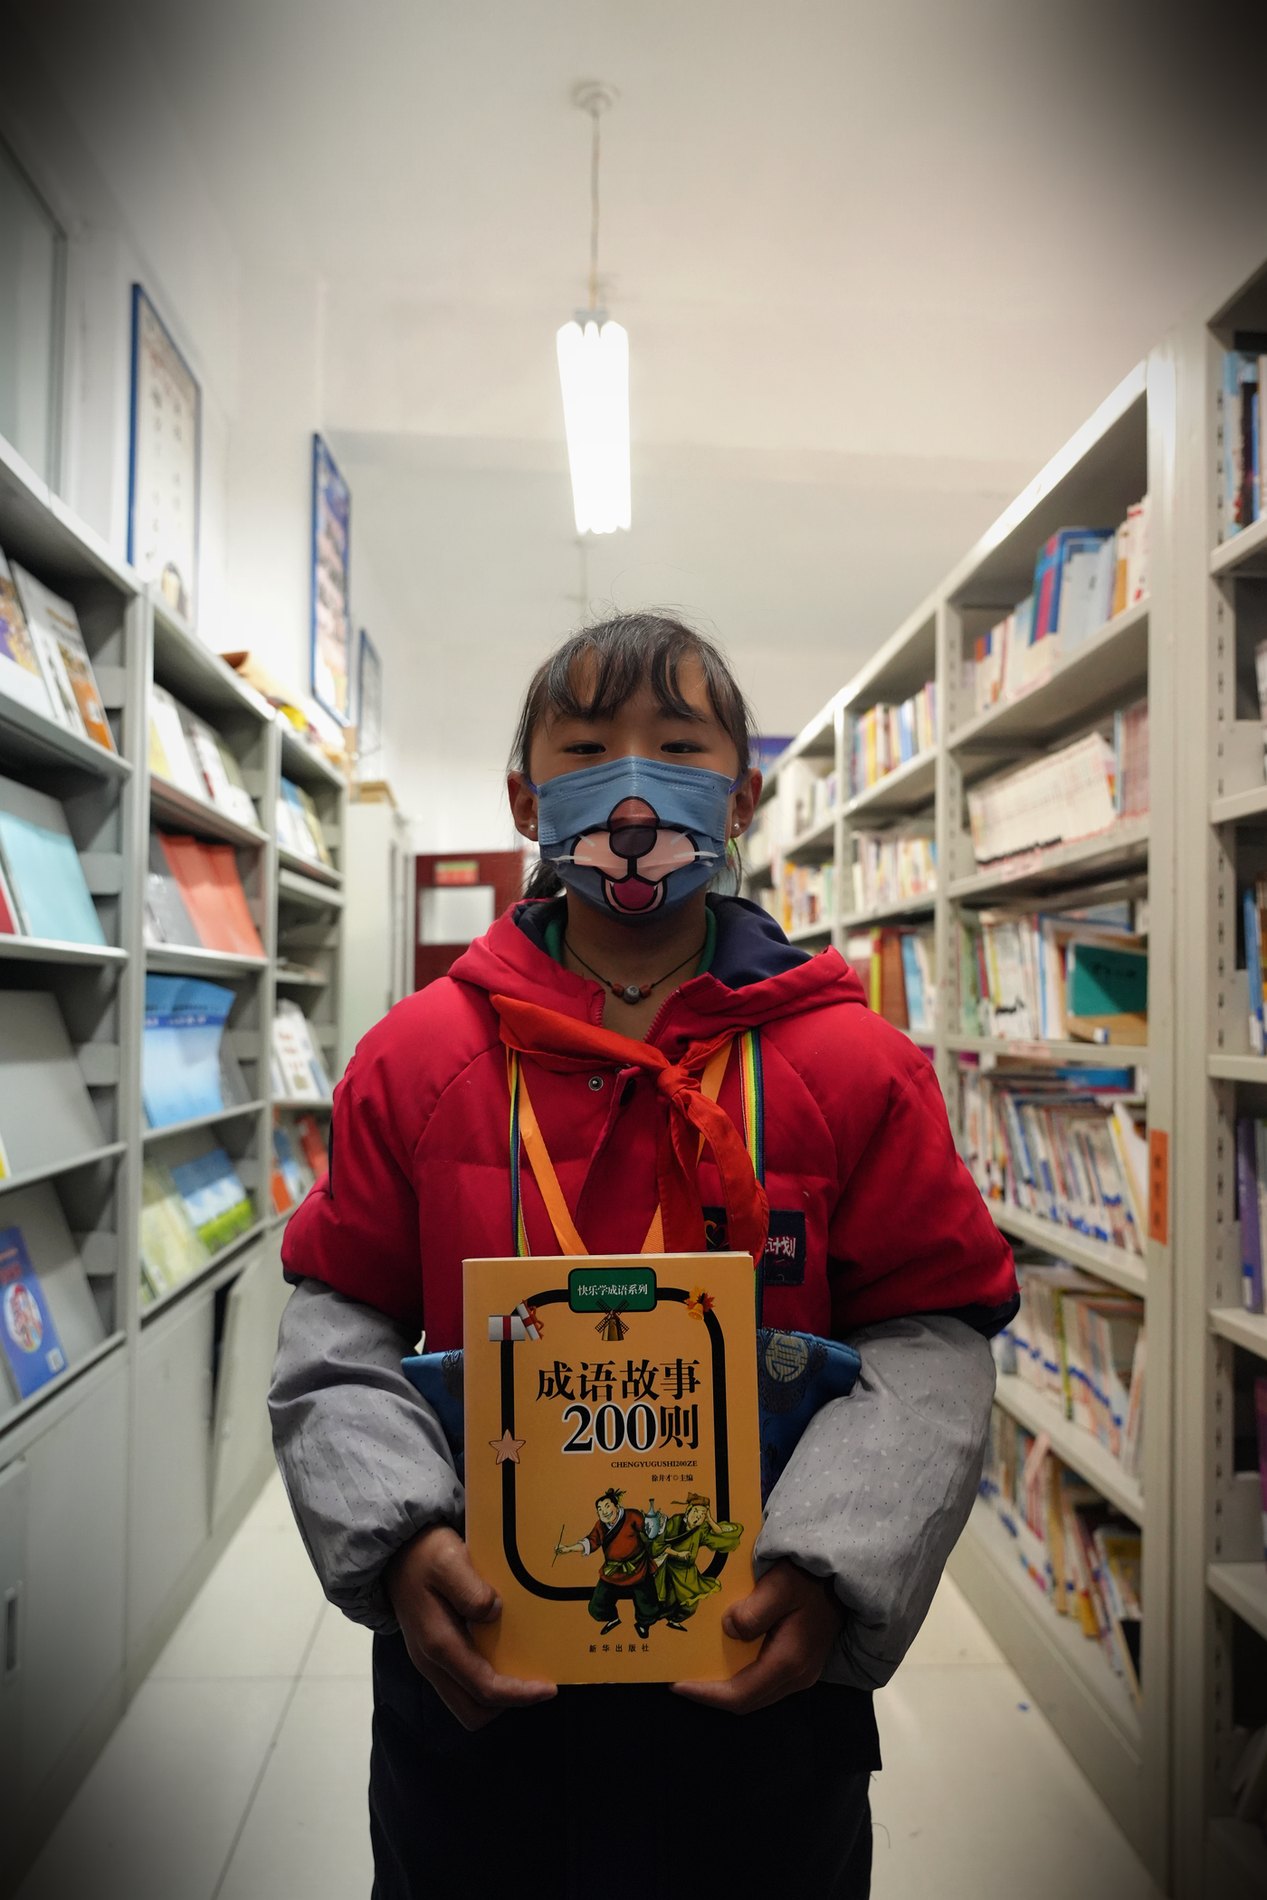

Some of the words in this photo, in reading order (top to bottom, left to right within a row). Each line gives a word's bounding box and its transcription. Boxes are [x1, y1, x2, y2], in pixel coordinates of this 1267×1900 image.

[765, 1236, 796, 1259] 计划
[577, 1284, 648, 1296] 快乐学成语系列
[536, 1358, 701, 1401] 成语故事
[562, 1402, 698, 1454] 200则
[611, 1460, 698, 1469] CHENGYUGUSHI200ZE
[589, 1643, 649, 1653] 新华出版社
